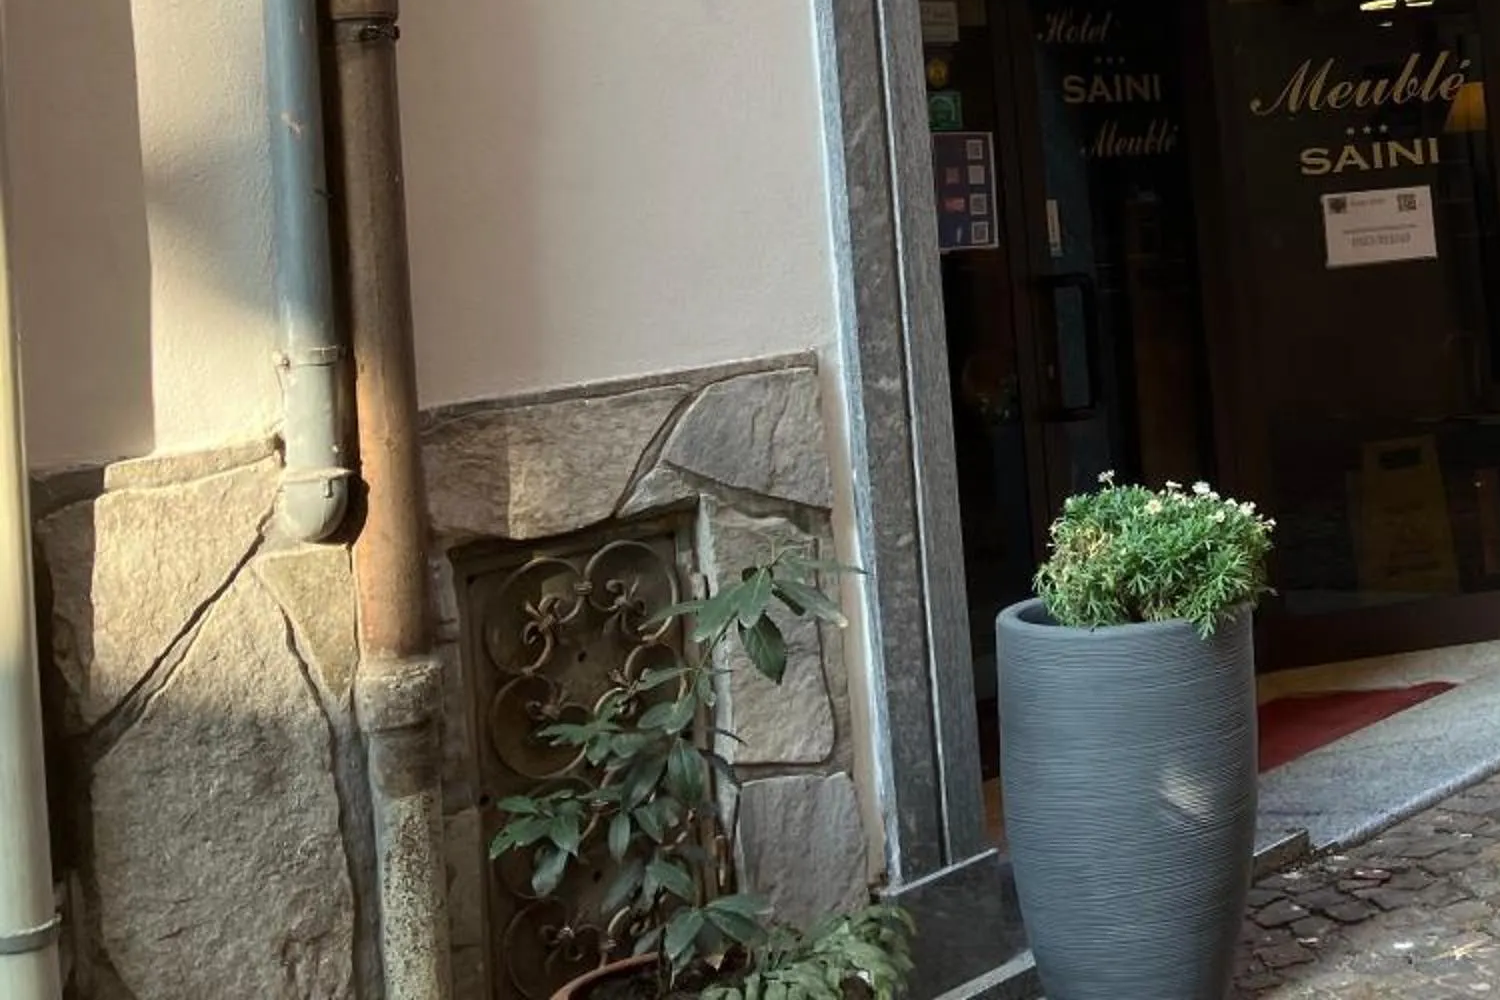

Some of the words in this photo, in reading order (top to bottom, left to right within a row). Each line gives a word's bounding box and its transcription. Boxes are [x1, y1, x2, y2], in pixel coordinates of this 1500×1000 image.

[1036, 6, 1113, 44] Hotel
[1062, 73, 1162, 104] SAINI
[1250, 50, 1472, 117] Meublé
[1080, 117, 1179, 157] Meublé
[1300, 137, 1440, 175] SAINI
